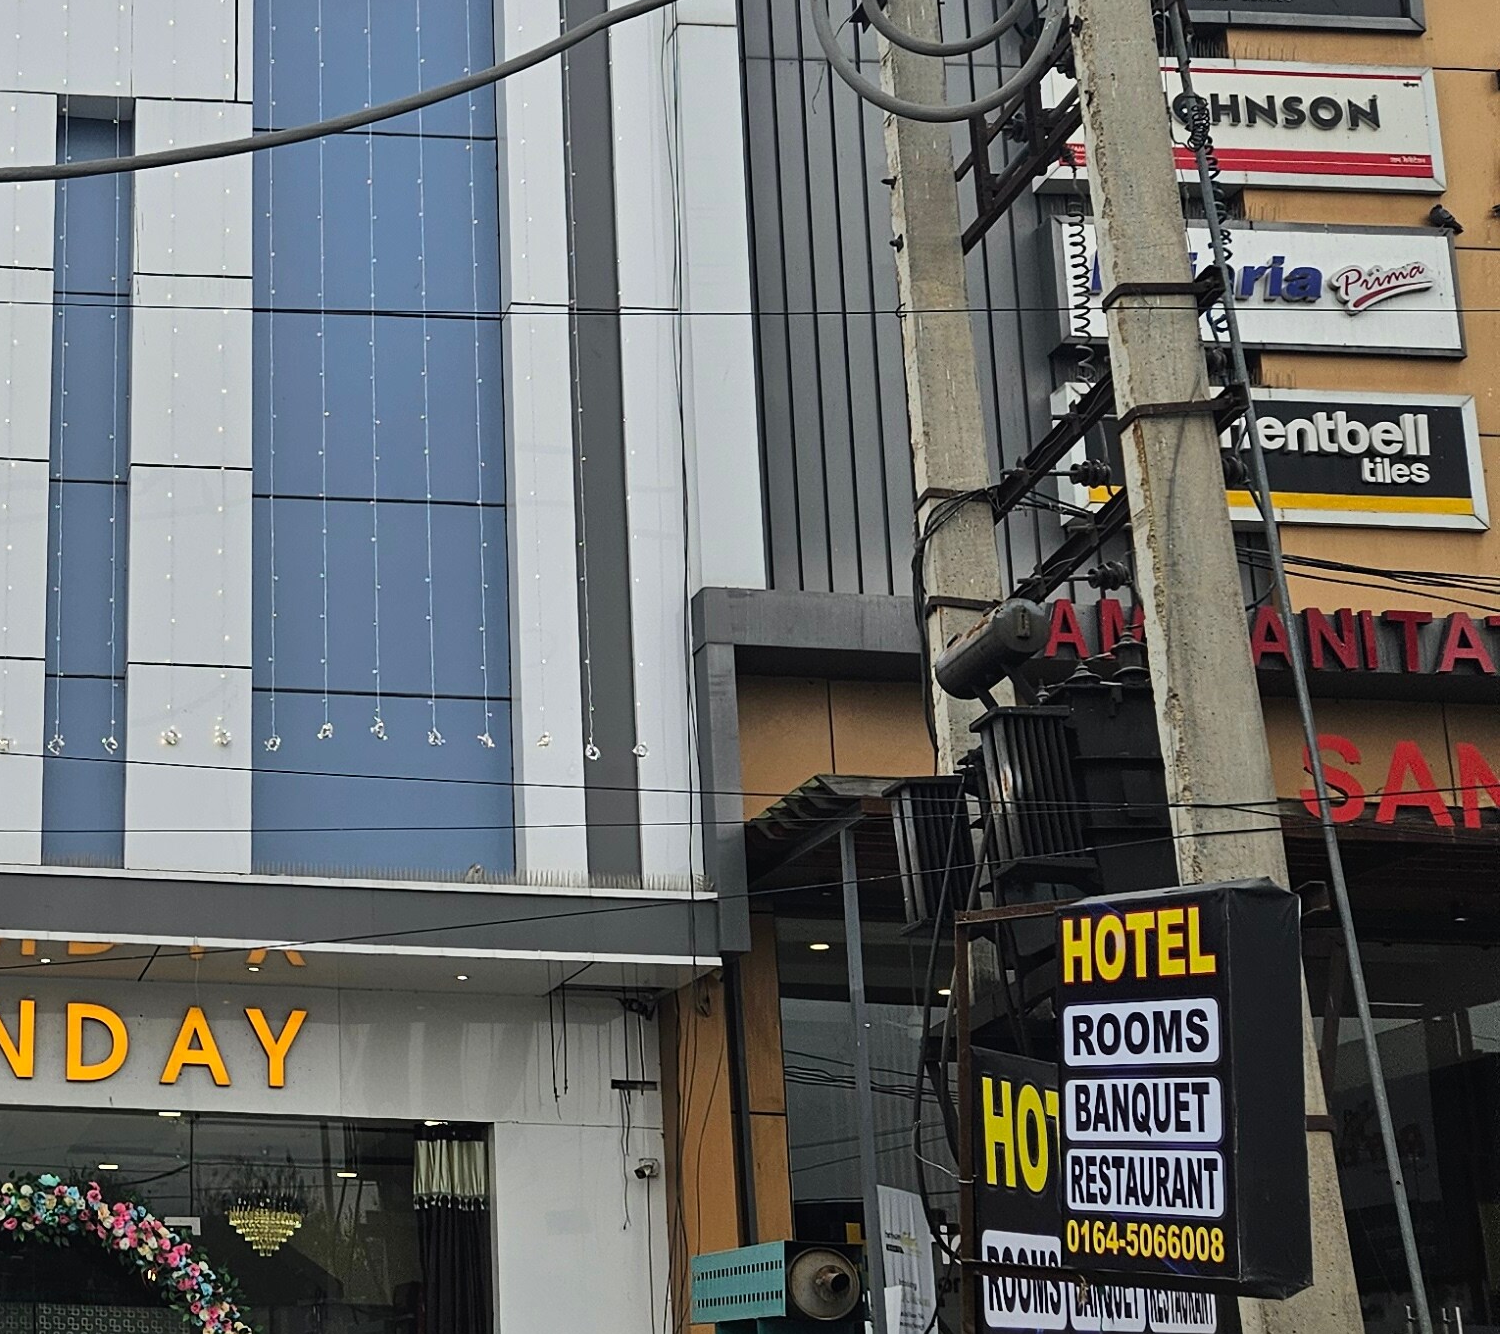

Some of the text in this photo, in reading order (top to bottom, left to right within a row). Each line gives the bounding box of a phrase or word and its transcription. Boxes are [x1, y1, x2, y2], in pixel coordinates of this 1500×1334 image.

[1171, 93, 1381, 132] OHNSON
[1336, 264, 1426, 300] Prima
[1361, 456, 1431, 484] tiles
[1251, 605, 1498, 673] ANITA
[1062, 906, 1217, 984] HOTEL
[1072, 1008, 1210, 1057] ROOMS
[1074, 1082, 1210, 1137] BANQUET
[1070, 1155, 1219, 1211] RESTAURANT
[1066, 1219, 1226, 1263] 0164-5066008
